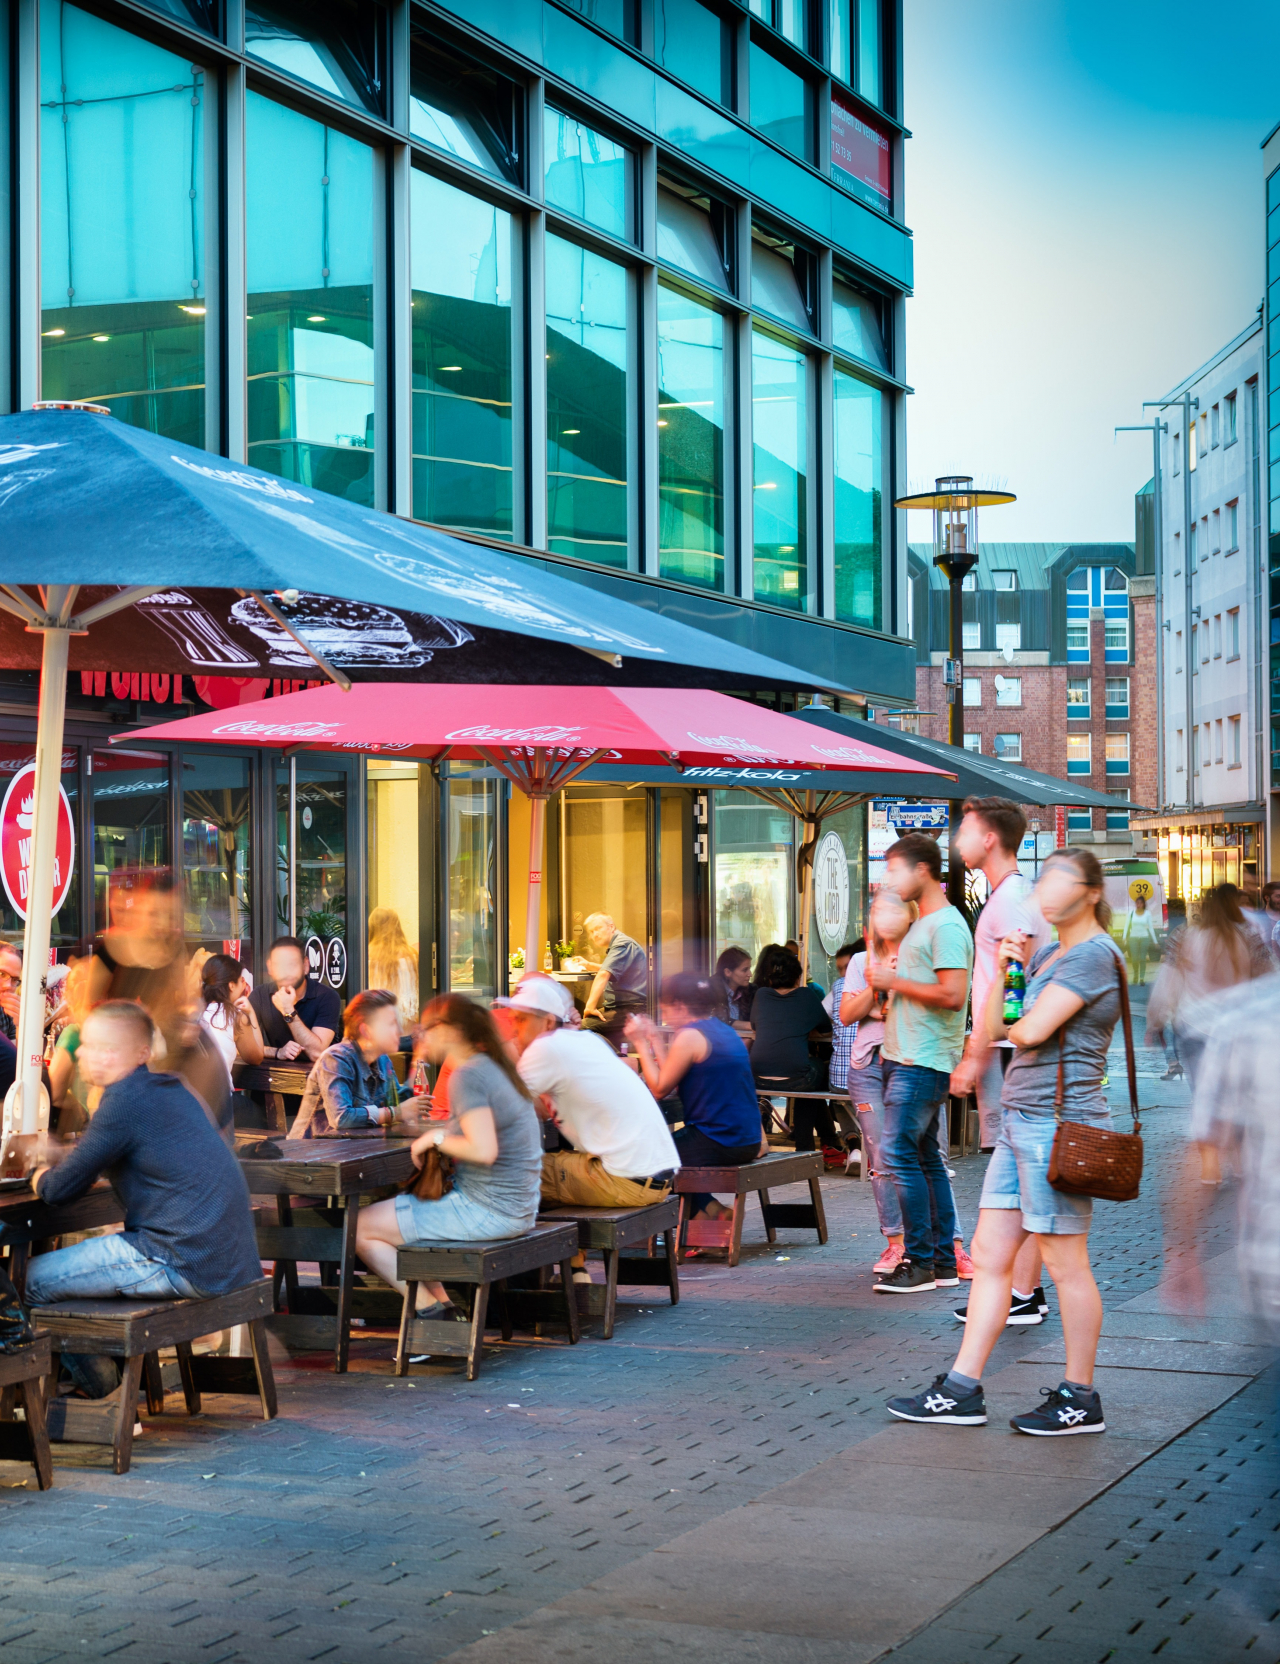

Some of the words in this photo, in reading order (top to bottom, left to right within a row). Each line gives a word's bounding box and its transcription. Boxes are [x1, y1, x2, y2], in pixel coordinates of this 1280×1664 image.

[826, 856, 839, 890] THE
[1136, 883, 1148, 893] 39
[825, 891, 840, 924] LORD
